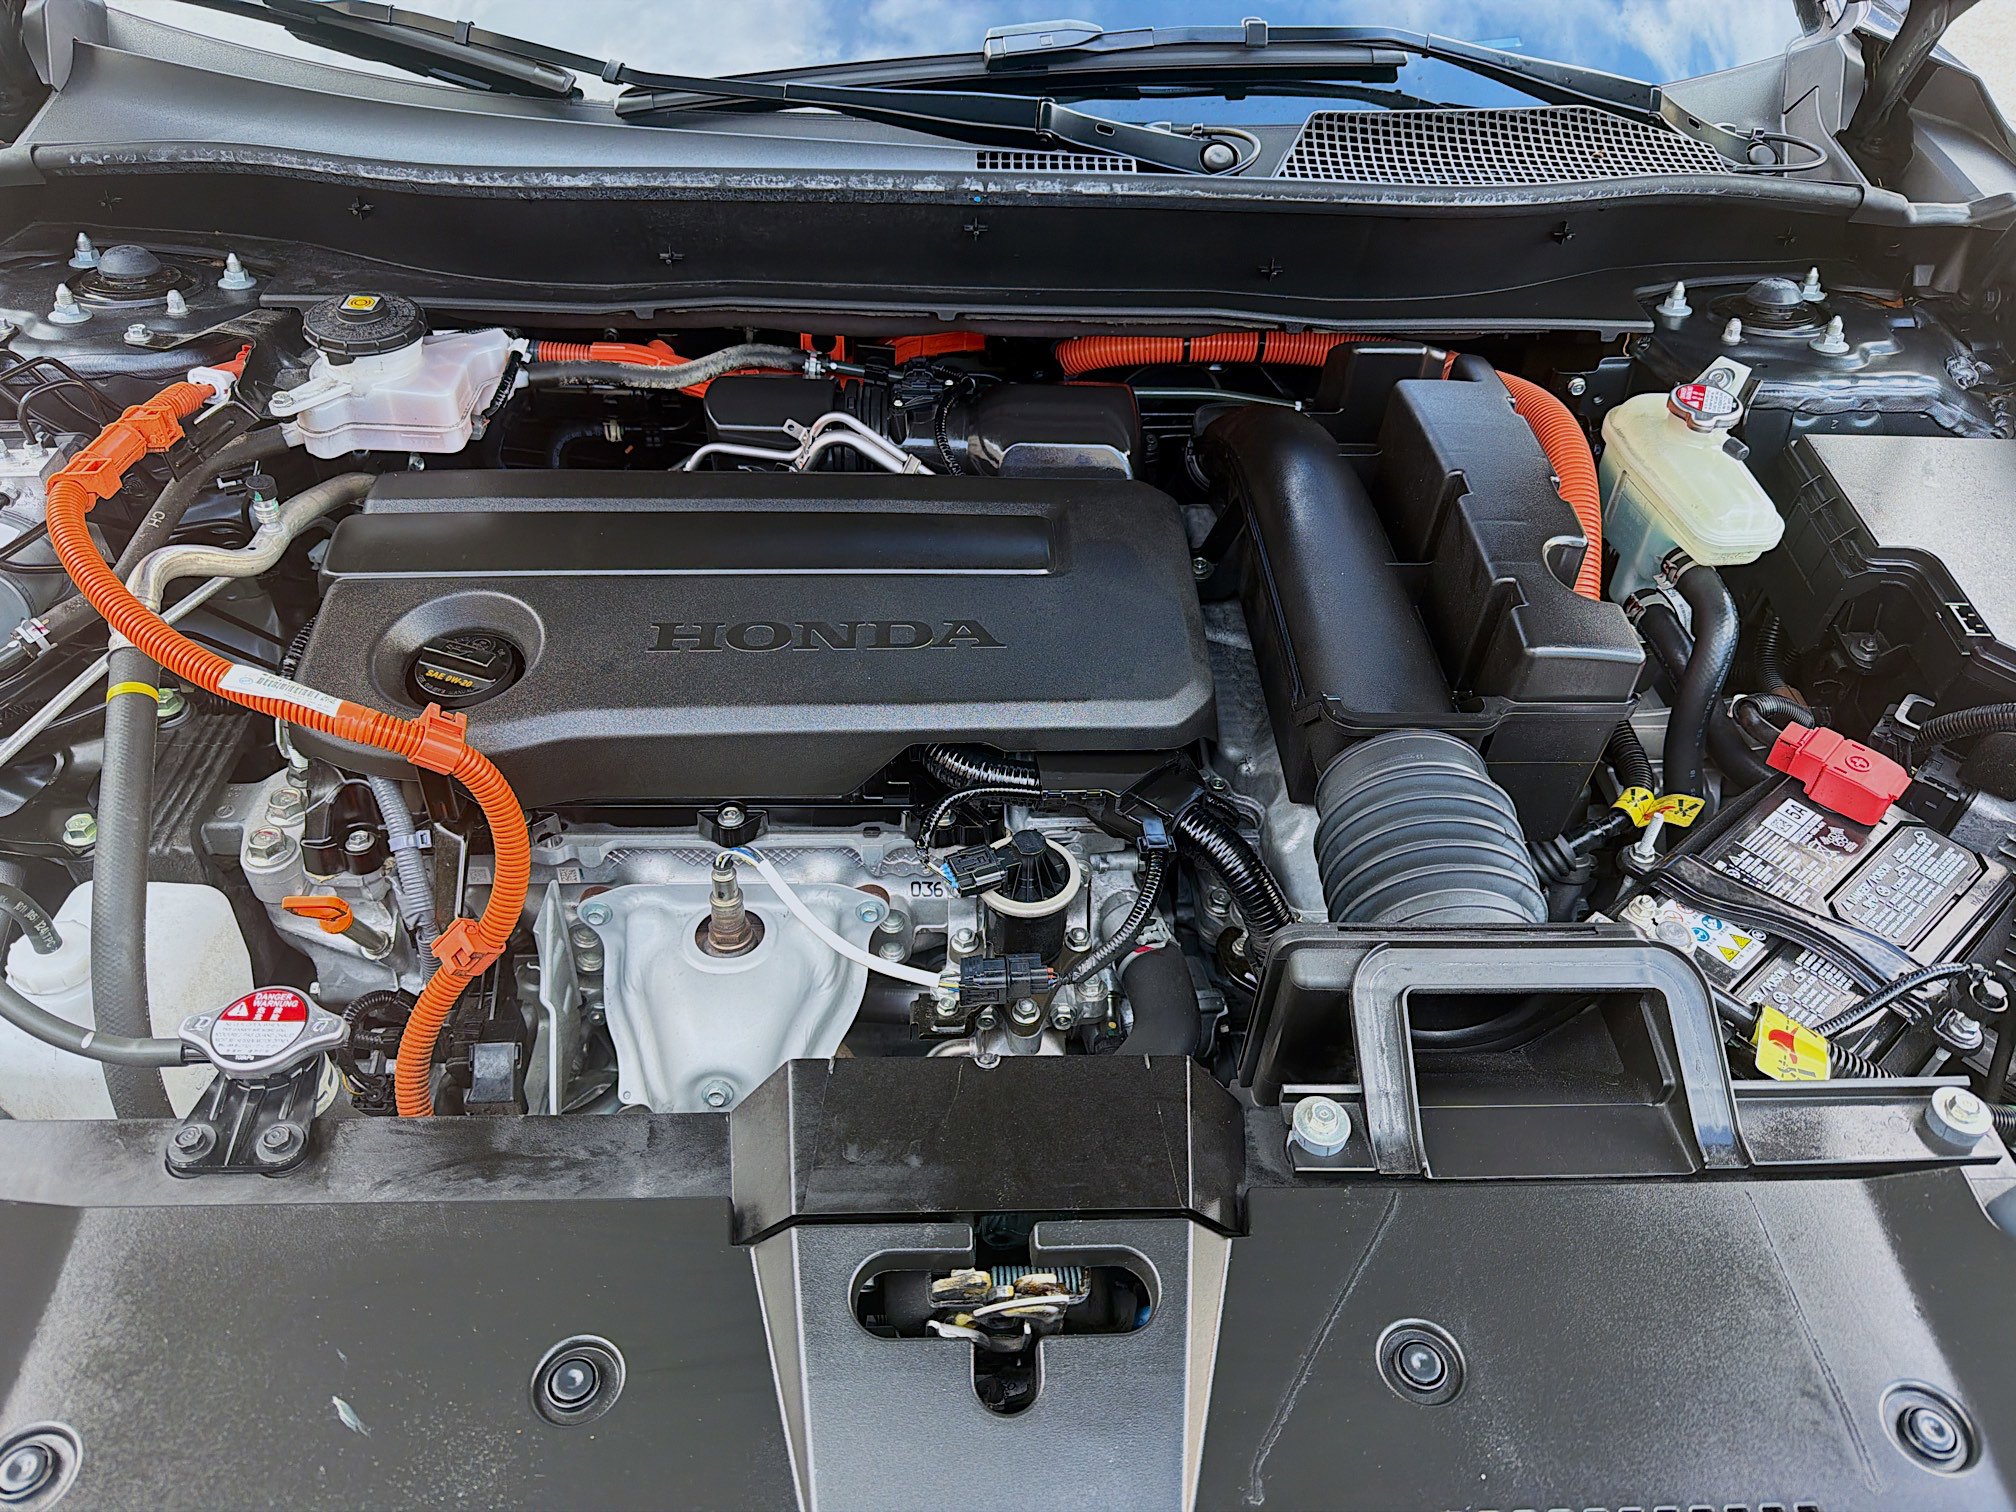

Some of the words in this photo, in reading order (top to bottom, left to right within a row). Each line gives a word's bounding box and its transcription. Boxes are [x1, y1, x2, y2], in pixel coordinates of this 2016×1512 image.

[646, 620, 1007, 652] HONDA
[425, 669, 447, 680] SAE
[445, 676, 474, 688] 0W-20
[911, 881, 943, 897] 036
[253, 1000, 299, 1008] WARNUNG
[255, 993, 294, 1001] DANGER
